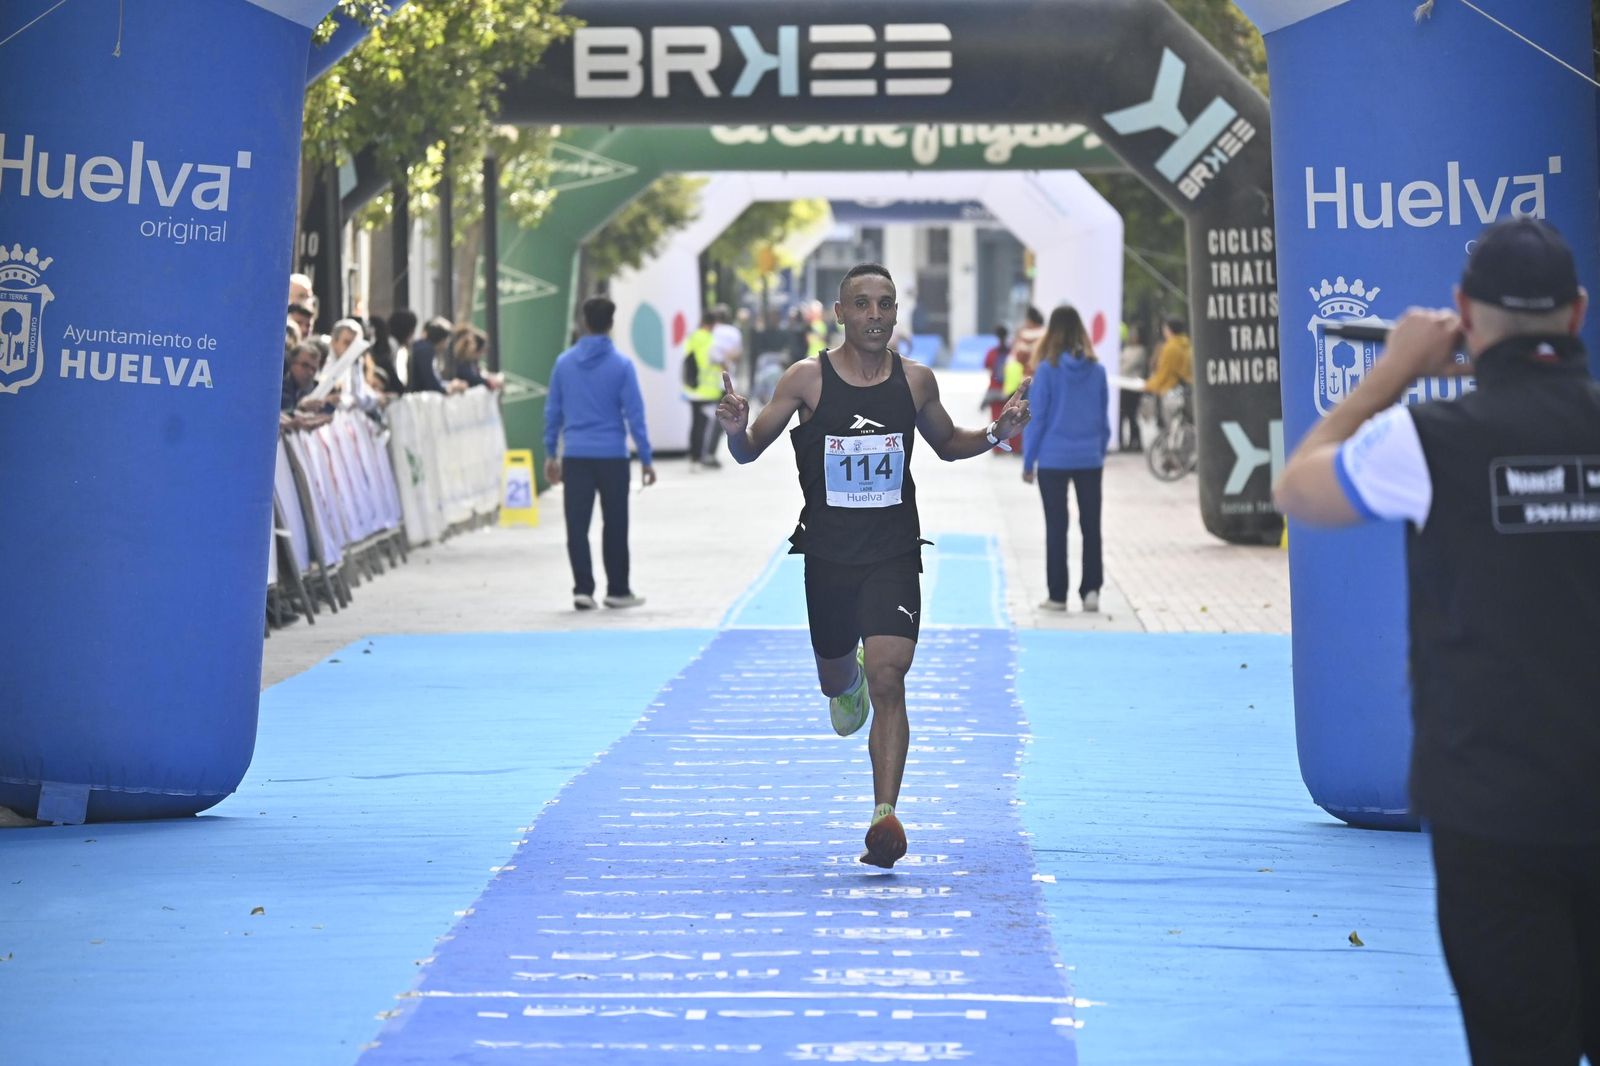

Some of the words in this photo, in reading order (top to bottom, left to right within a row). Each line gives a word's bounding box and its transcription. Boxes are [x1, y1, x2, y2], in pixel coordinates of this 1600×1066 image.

[0, 133, 232, 212] Huelva
[1305, 161, 1547, 229] Huelva
[140, 216, 227, 244] original
[1207, 226, 1274, 255] CICLIS
[1210, 260, 1275, 287] TRIATL
[1207, 292, 1278, 320] ATLETIS
[63, 324, 191, 348] Ayuntamiento
[197, 334, 217, 350] de
[1229, 324, 1276, 351] TRAI
[59, 349, 214, 388] HUELVA
[1206, 356, 1279, 385] CANICR
[1401, 376, 1478, 404] HUE
[829, 438, 845, 451] 2K
[885, 435, 899, 448] 2K
[839, 453, 893, 481] 114
[847, 492, 885, 503] Huelva
